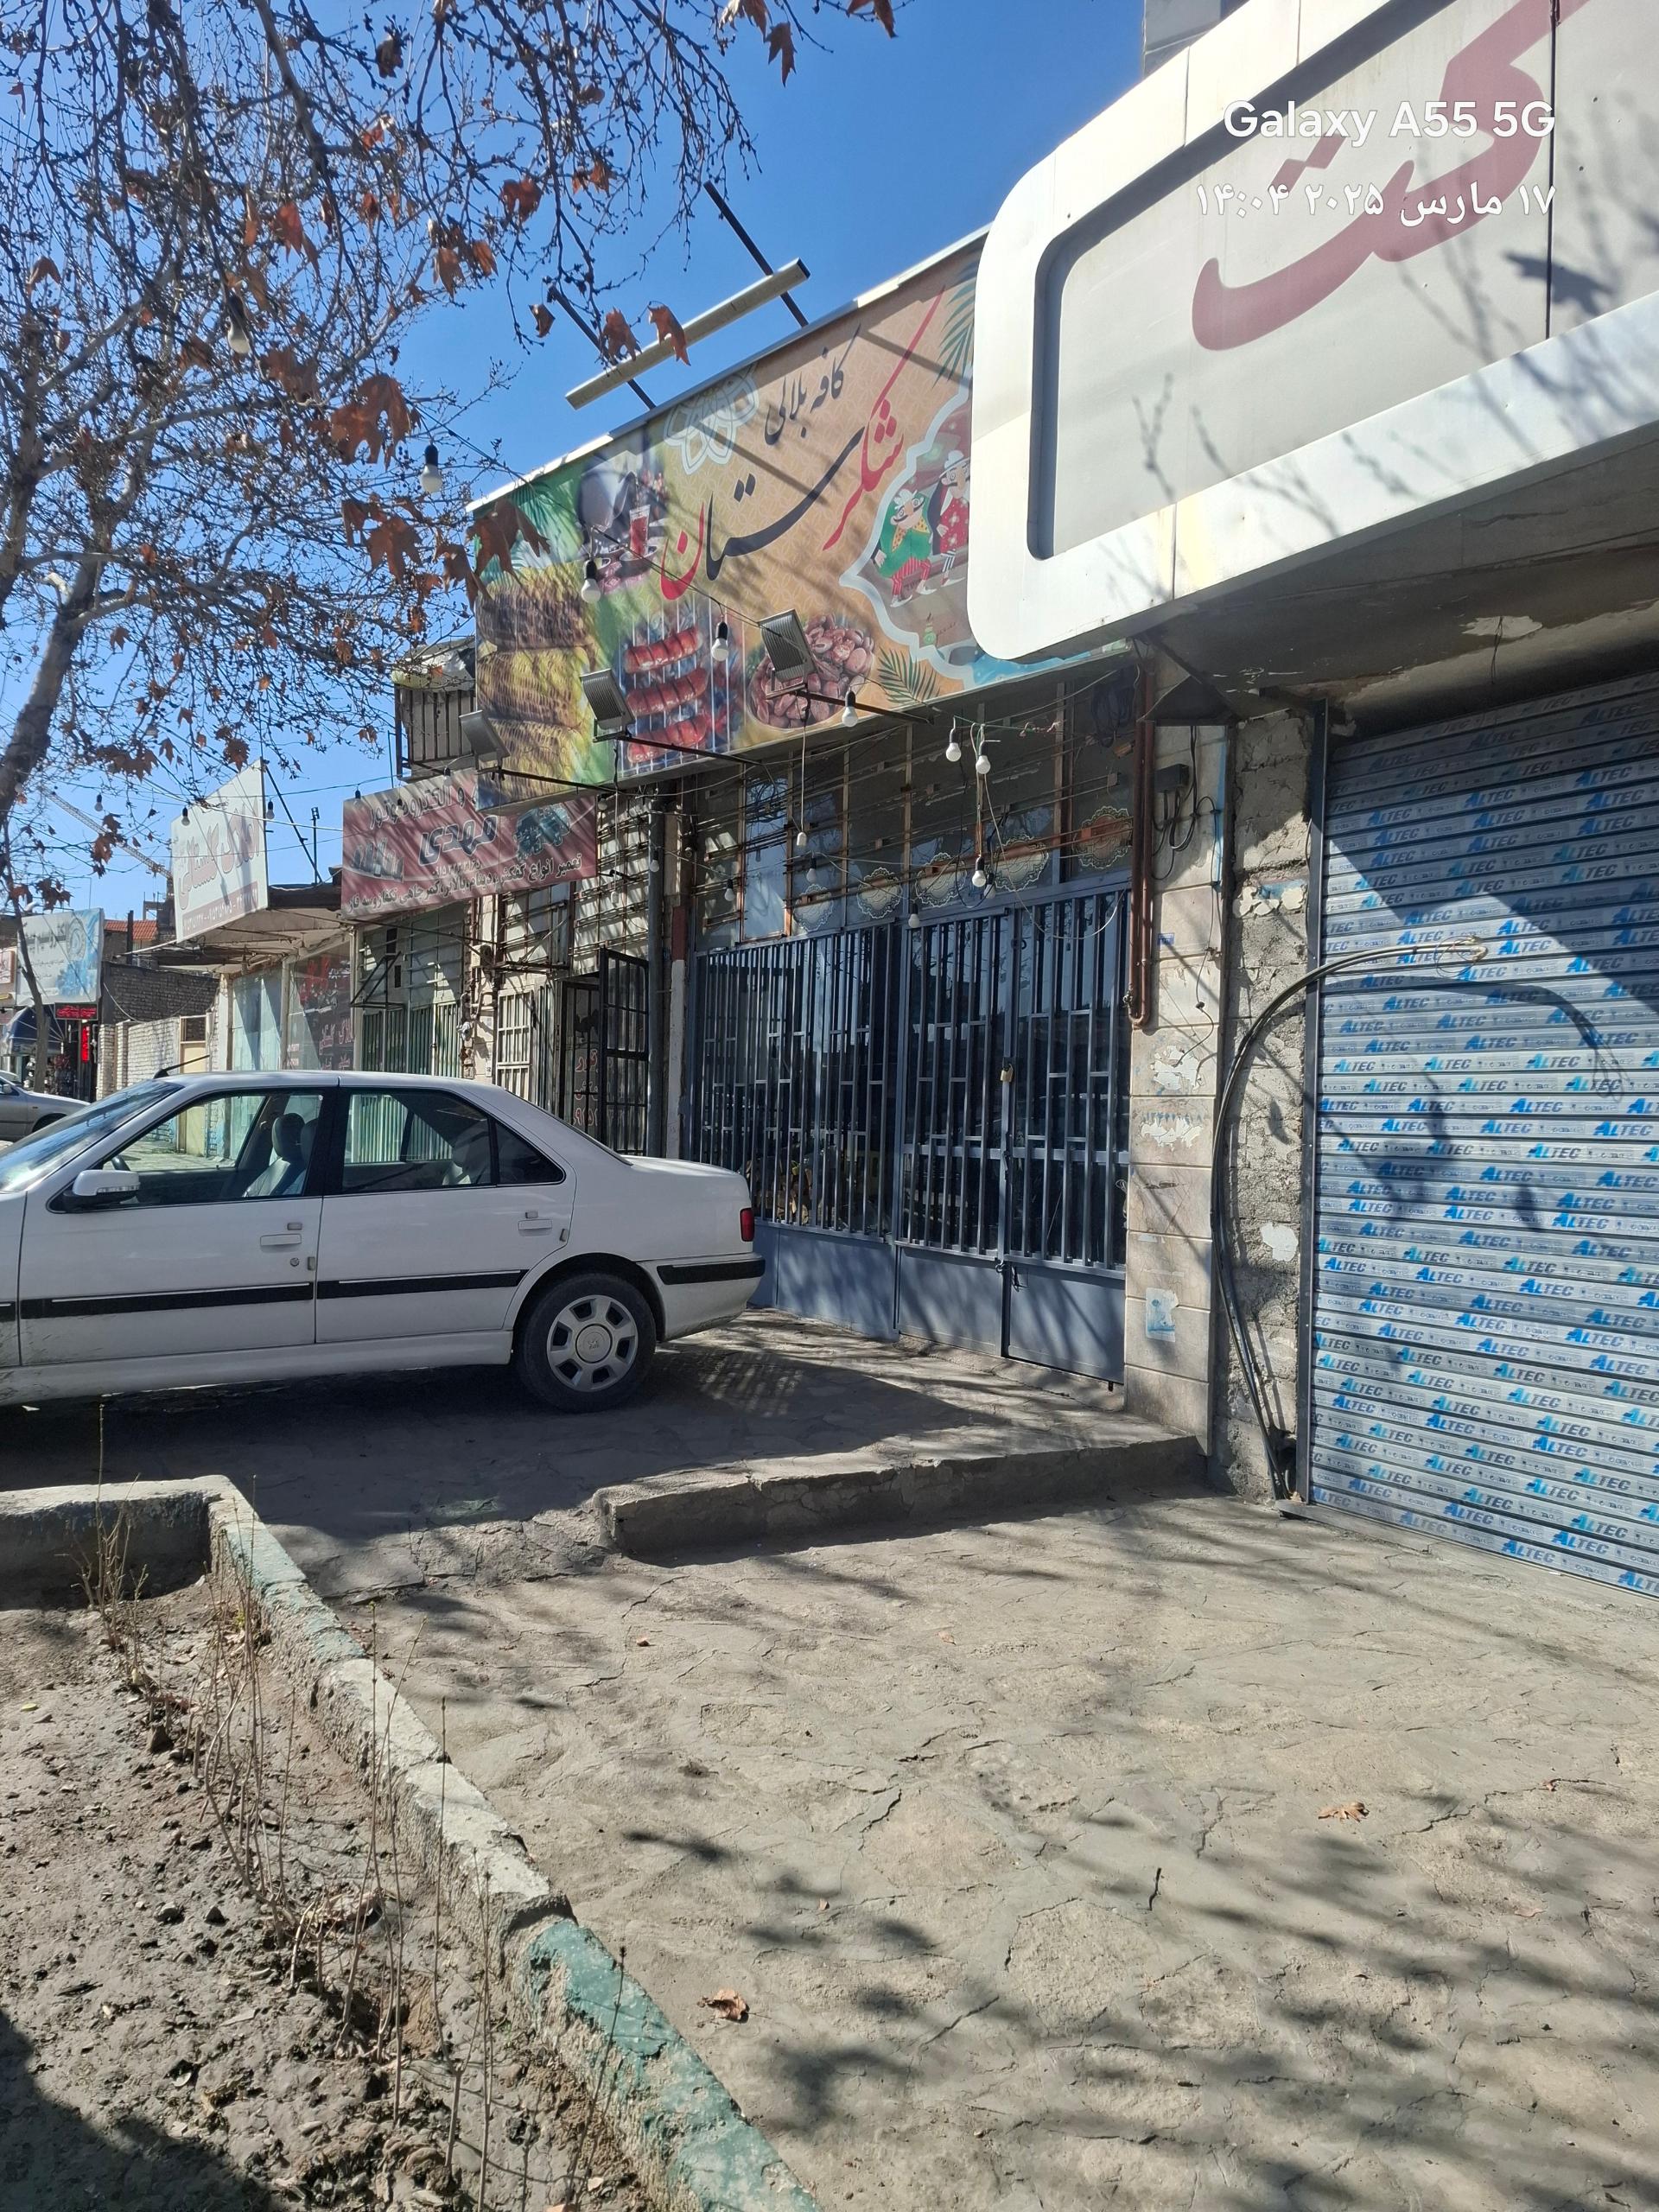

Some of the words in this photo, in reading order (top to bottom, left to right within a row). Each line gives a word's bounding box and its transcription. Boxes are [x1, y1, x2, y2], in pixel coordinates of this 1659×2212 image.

[810, 325, 861, 413] کافه
[765, 374, 809, 445] بلالی
[1330, 798, 1356, 812] TEC
[1367, 807, 1411, 826] ALTEC
[1464, 788, 1515, 808] ALTEC
[1575, 766, 1632, 788] ALTEC
[1374, 828, 1419, 845] ALTEC
[1473, 810, 1524, 829] ALTEC
[1586, 788, 1644, 810] ALTEC
[418, 814, 499, 867] مهدی
[1370, 850, 1415, 868] ALTEC
[1466, 834, 1518, 852] ALTEC
[1577, 815, 1636, 836] ALTEC
[528, 857, 554, 883] انواع
[556, 853, 582, 878] تعمیر
[1354, 874, 1397, 890] ALTEC
[1447, 859, 1496, 877] ALTEC
[1551, 842, 1608, 862] ALTEC
[1360, 893, 1403, 909] ALTEC
[1454, 879, 1503, 896] ALTEC
[1560, 863, 1618, 882] ALTEC
[1404, 909, 1452, 925] ALTEC
[1508, 895, 1564, 912] ALTEC
[1326, 940, 1349, 951] TEC
[1396, 930, 1444, 944] ALTEC
[1497, 918, 1550, 935] ALTEC
[1498, 939, 1552, 955] ALTEC
[1359, 975, 1403, 988] ALTEC
[1456, 966, 1507, 981] ALTEC
[1566, 957, 1622, 973] ALTEC
[1382, 995, 1429, 1010] ALTEC
[1485, 989, 1540, 1004] ALTEC
[1339, 1019, 1383, 1033] ALTEC
[1435, 1014, 1486, 1028] ALTEC
[1333, 1058, 1376, 1071] ALTEC
[1424, 1056, 1471, 1070] ALTEC
[1525, 1053, 1580, 1068] ALTEC
[1364, 1039, 1410, 1052] ALTEC
[1465, 1034, 1517, 1050] ALTEC
[1363, 1078, 1408, 1092] ALTEC
[1458, 1077, 1508, 1092] ALTEC
[1564, 1076, 1621, 1091] ALTEC
[1407, 1097, 1455, 1113] ALTEC
[1510, 1098, 1562, 1113] ALTEC
[1381, 1119, 1427, 1133] ALTEC
[1480, 1119, 1532, 1135] ALTEC
[1593, 1121, 1653, 1137] ALTEC
[1337, 1138, 1379, 1152] ALTEC
[1427, 1141, 1474, 1156] ALTEC
[1526, 1143, 1581, 1160] ALTEC
[1377, 1162, 1424, 1178] ALTEC
[1479, 1166, 1534, 1184] ALTEC
[1596, 1171, 1658, 1190] ALTEC
[1346, 1180, 1392, 1196] ALTEC
[1445, 1186, 1496, 1203] ALTEC
[1556, 1192, 1614, 1211] ALTEC
[1348, 1198, 1392, 1215] ALTEC
[1443, 1205, 1494, 1223] ALTEC
[1552, 1212, 1609, 1231] ALTEC
[1358, 1223, 1404, 1239] ALTEC
[1459, 1230, 1510, 1249] ALTEC
[1572, 1239, 1632, 1261] ALTEC
[1403, 1246, 1449, 1264] ALTEC
[1503, 1256, 1556, 1275] ALTEC
[1325, 1257, 1366, 1274] ALTEC
[1415, 1267, 1464, 1286] ALTEC
[1518, 1278, 1573, 1298] ALTEC
[1359, 1300, 1403, 1317] ALTEC
[1454, 1313, 1506, 1332] ALTEC
[1565, 1327, 1624, 1349] ALTEC
[1368, 1281, 1414, 1300] ALTEC
[1469, 1294, 1523, 1314] ALTEC
[1585, 1308, 1645, 1331] ALTEC
[1377, 1323, 1424, 1342] ALTEC
[1476, 1338, 1529, 1358] ALTEC
[1589, 1355, 1649, 1377] ALTEC
[1396, 1347, 1441, 1367] ALTEC
[1494, 1362, 1545, 1383] ALTEC
[1318, 1353, 1359, 1373] ALTEC
[1406, 1370, 1454, 1390] ALTEC
[1507, 1387, 1560, 1410] ALTEC
[1332, 1395, 1376, 1414] ALTEC
[1426, 1414, 1475, 1436] ALTEC
[1533, 1436, 1588, 1459] ALTEC
[1340, 1378, 1382, 1397] ALTEC
[1431, 1395, 1481, 1417] ALTEC
[1535, 1414, 1591, 1439] ALTEC
[1334, 1433, 1376, 1455] ALTEC
[1424, 1454, 1472, 1478] ALTEC
[1524, 1477, 1580, 1503] ALTEC
[1369, 1423, 1414, 1445] ALTEC
[1465, 1444, 1516, 1467] ALTEC
[1573, 1467, 1630, 1492] ALTEC
[1348, 1478, 1392, 1500] ALTEC
[1443, 1502, 1493, 1526] ALTEC
[1551, 1530, 1609, 1557] ALTEC
[1367, 1465, 1412, 1486] ALTEC
[1461, 1487, 1513, 1512] ALTEC
[1570, 1513, 1629, 1541] ALTEC
[1399, 1511, 1447, 1535] ALTEC
[1502, 1539, 1555, 1565] ALTEC
